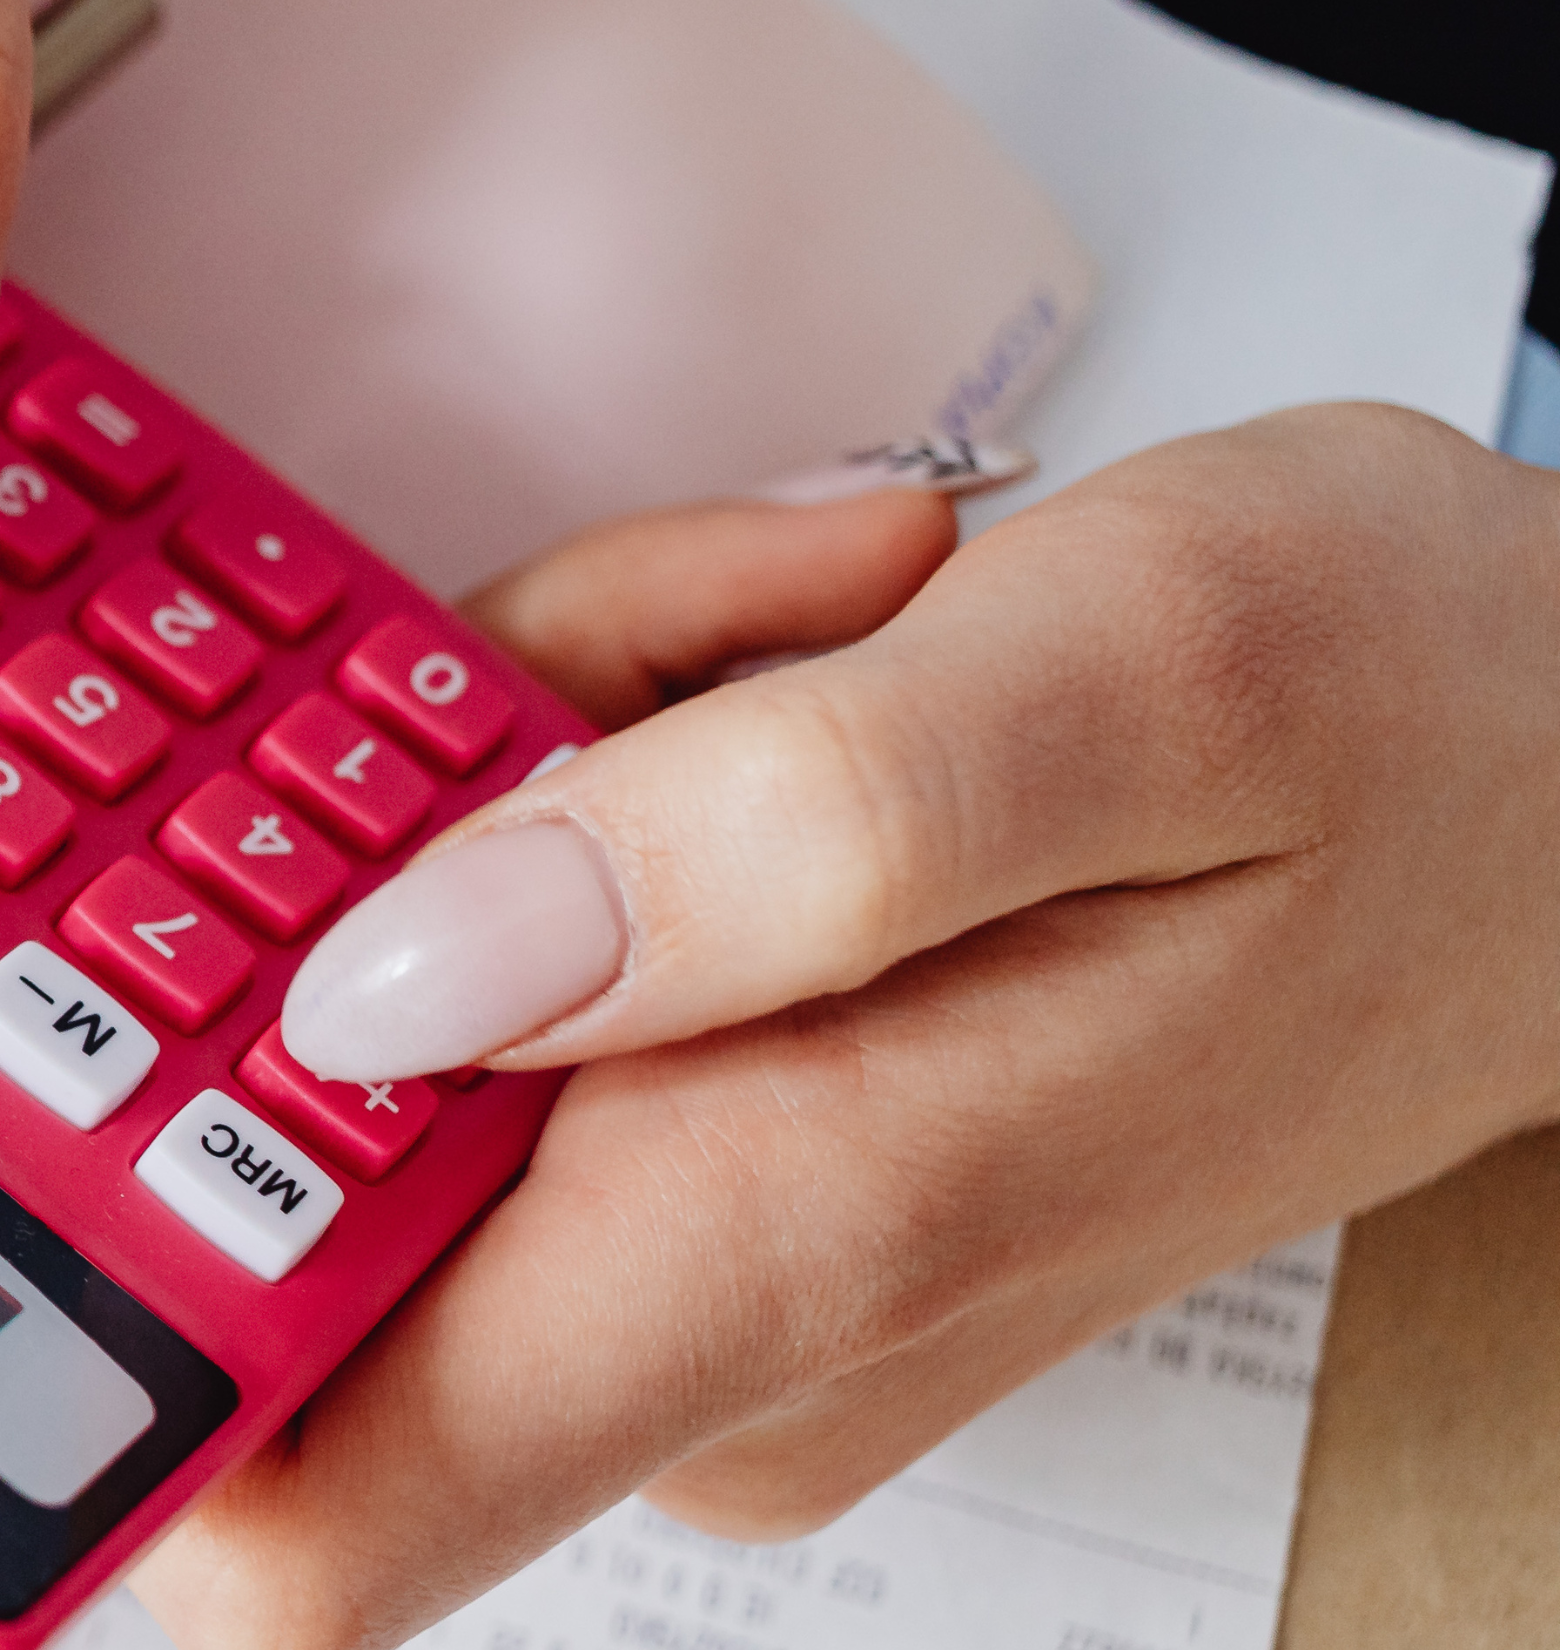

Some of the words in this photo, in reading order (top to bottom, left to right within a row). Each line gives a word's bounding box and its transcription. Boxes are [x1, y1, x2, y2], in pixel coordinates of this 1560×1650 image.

[150, 590, 218, 647] 2
[53, 674, 120, 727] 5
[409, 652, 469, 706] 0
[333, 738, 377, 784] 1
[238, 814, 294, 856] 4
[132, 912, 199, 960] 7
[201, 1123, 308, 1215] MRC
